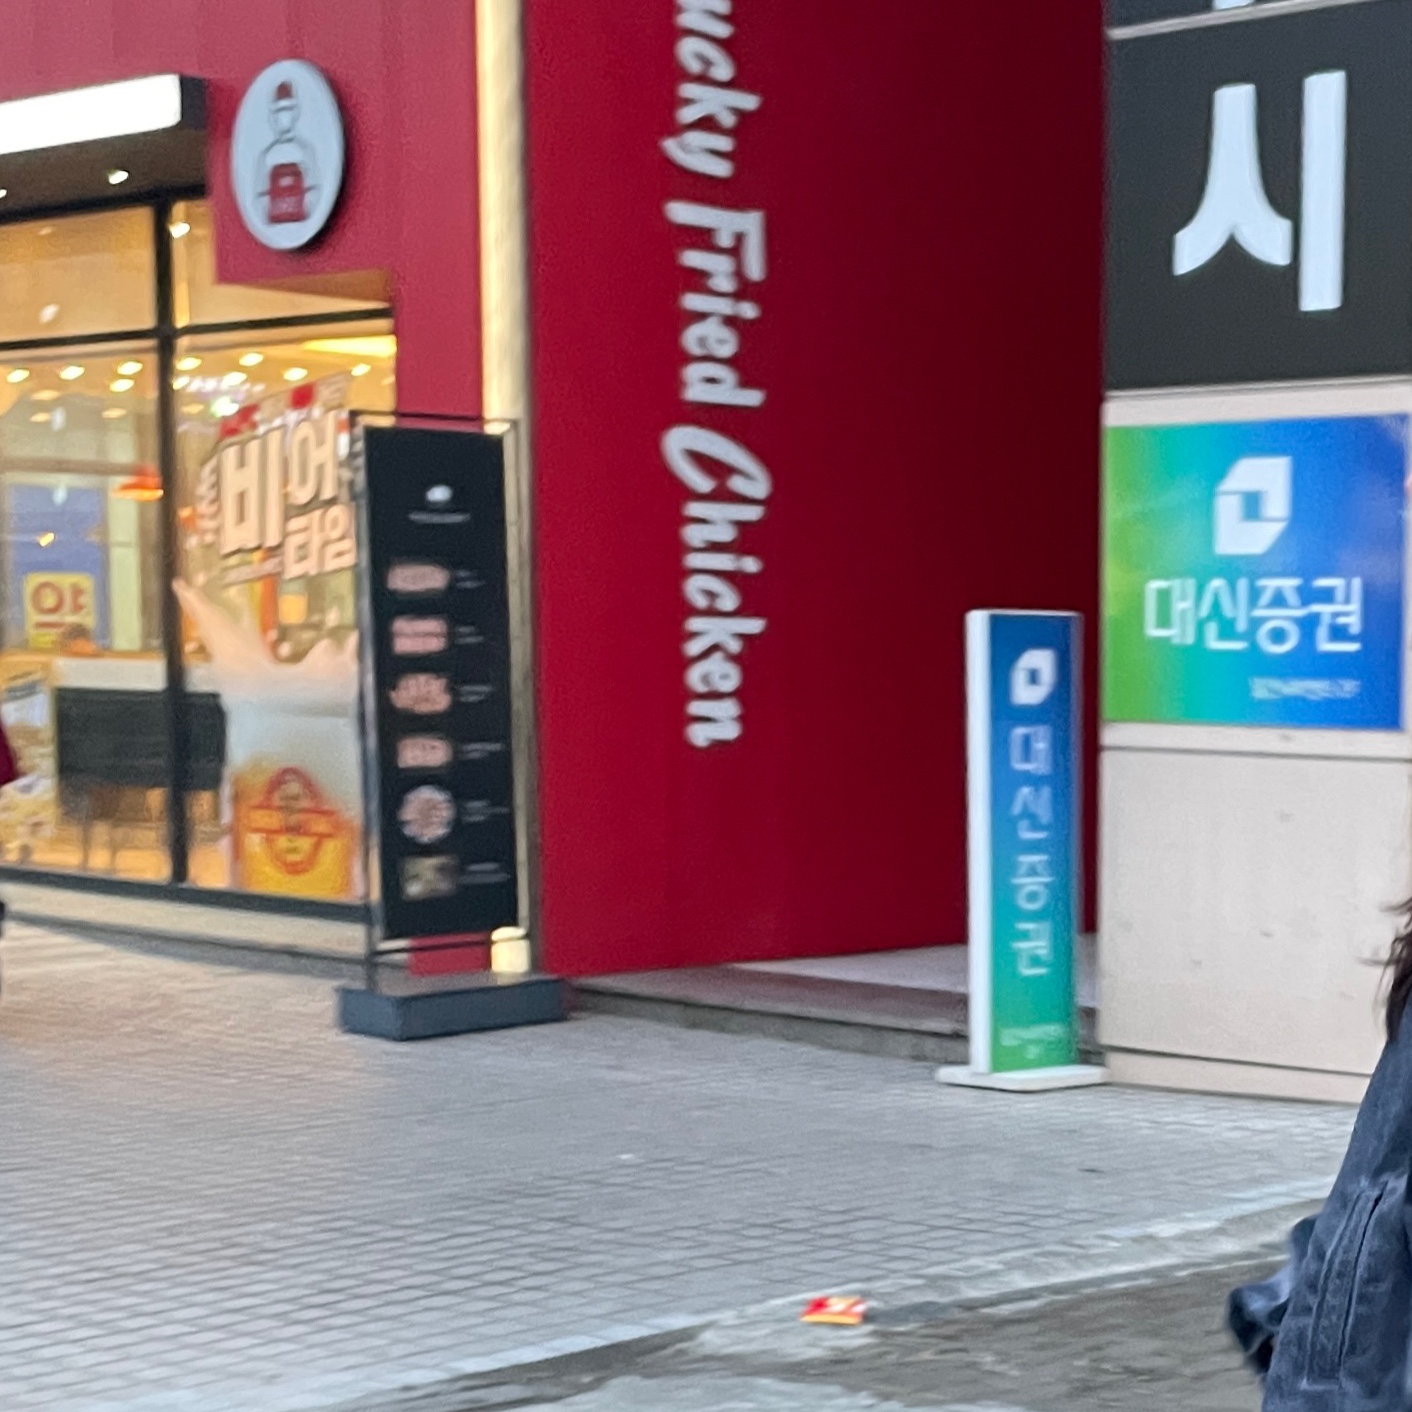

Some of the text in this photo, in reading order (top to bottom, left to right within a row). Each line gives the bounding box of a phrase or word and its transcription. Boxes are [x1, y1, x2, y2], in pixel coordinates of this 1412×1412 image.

[664, 199, 768, 408] Fried
[660, 424, 773, 749] Chicken
[1144, 576, 1364, 654] 대신증권
[1009, 723, 1056, 977] 대신증권
